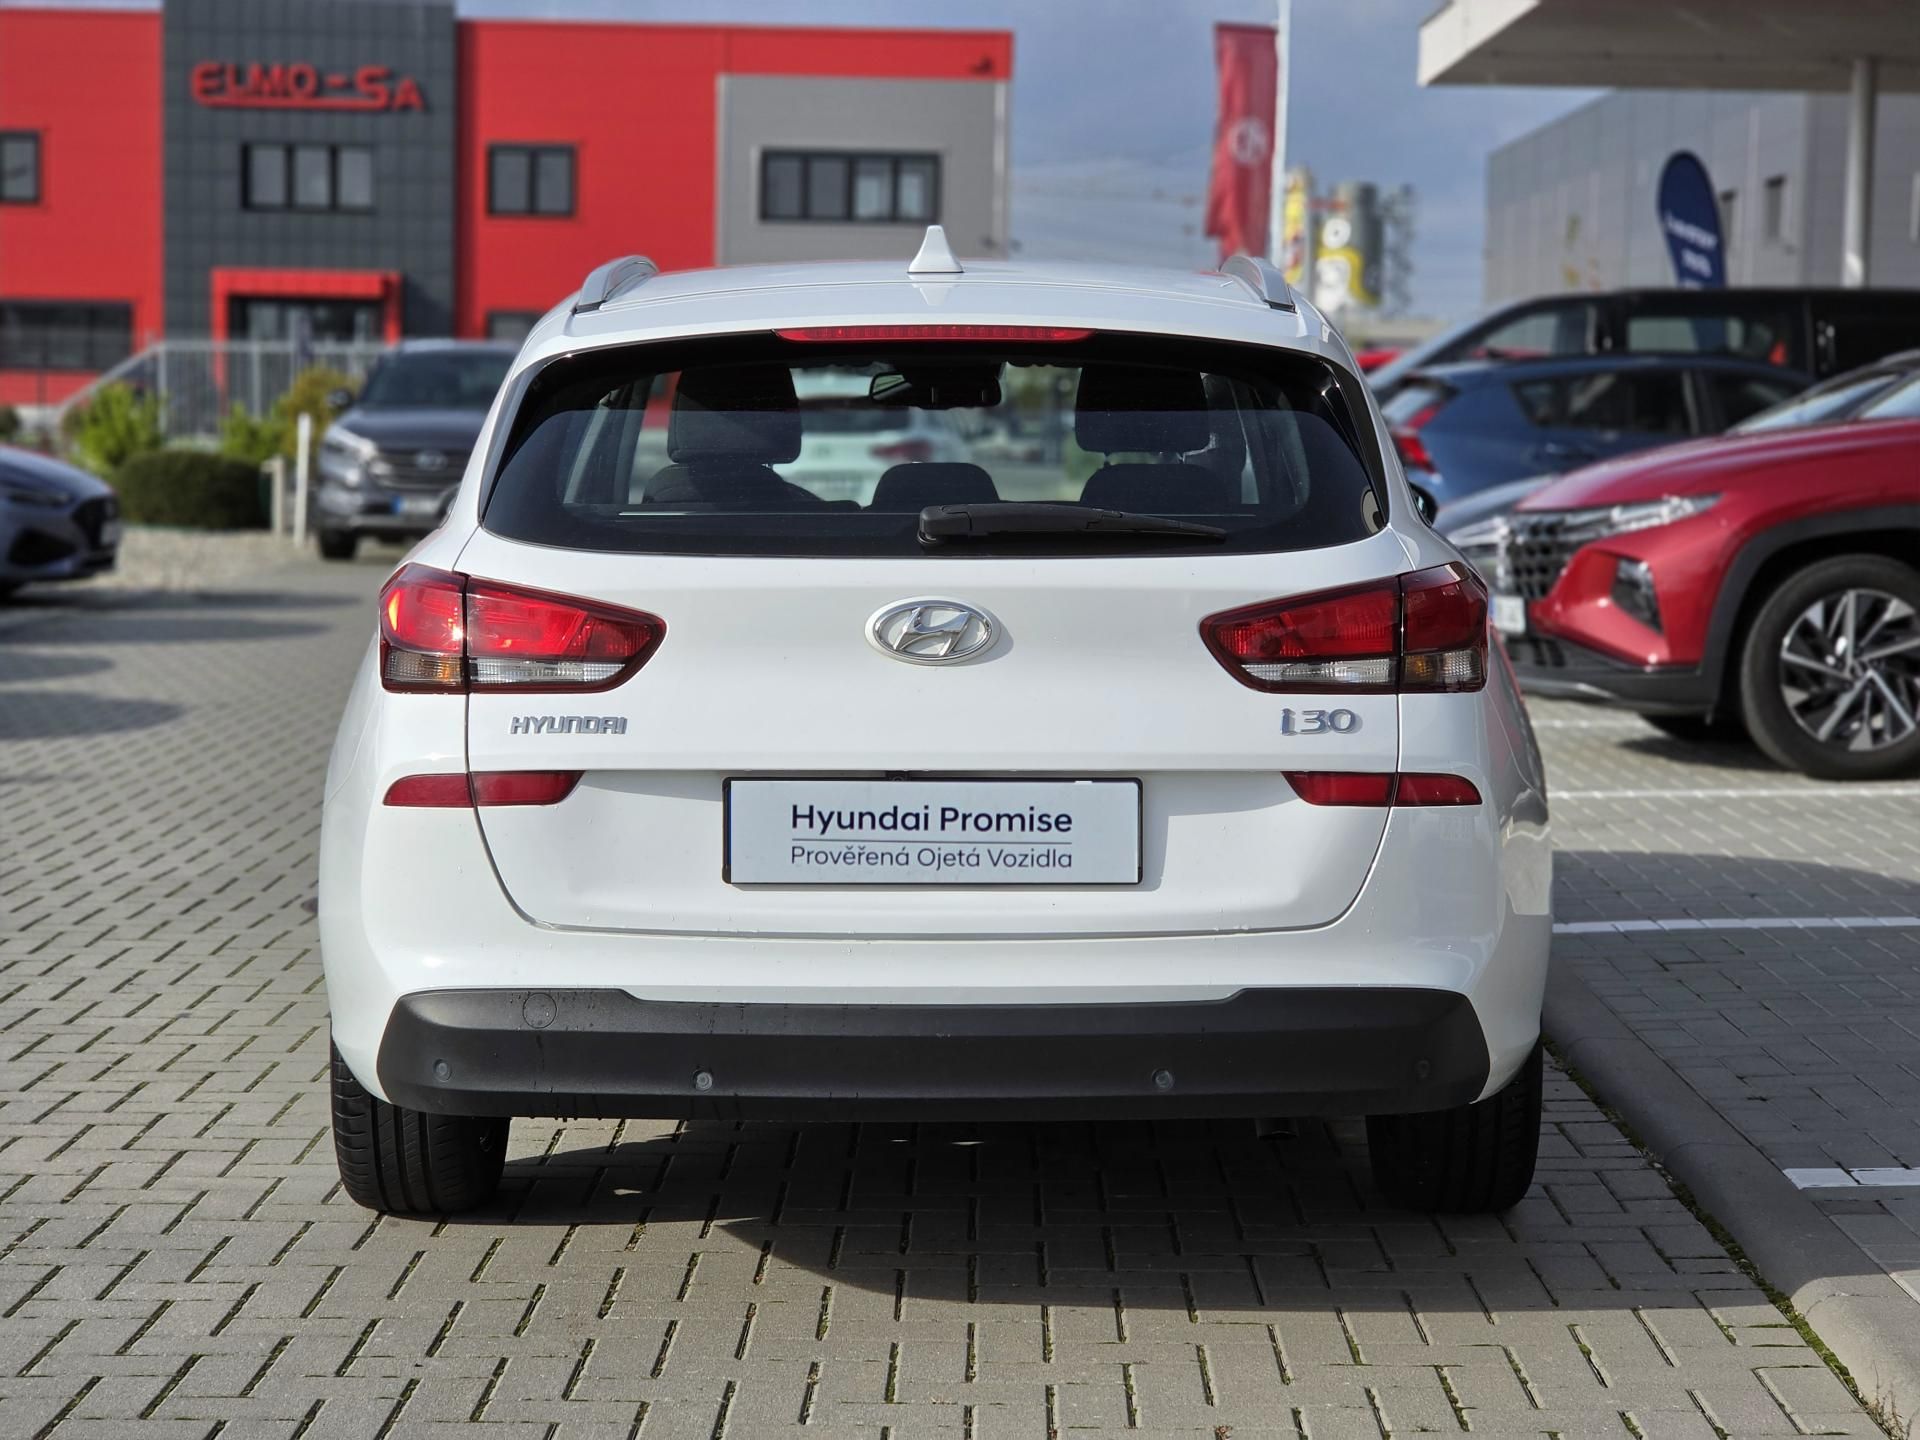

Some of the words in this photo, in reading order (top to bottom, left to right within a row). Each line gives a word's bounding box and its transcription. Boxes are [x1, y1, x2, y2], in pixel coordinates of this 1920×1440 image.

[510, 716, 628, 735] HYUNDAI
[1281, 708, 1359, 736] i30
[791, 804, 929, 835] Hyundai
[940, 805, 1073, 833] Promise
[791, 844, 910, 866] Prověřená
[917, 846, 981, 871] Ojetá
[987, 848, 1073, 868] Vozidla
